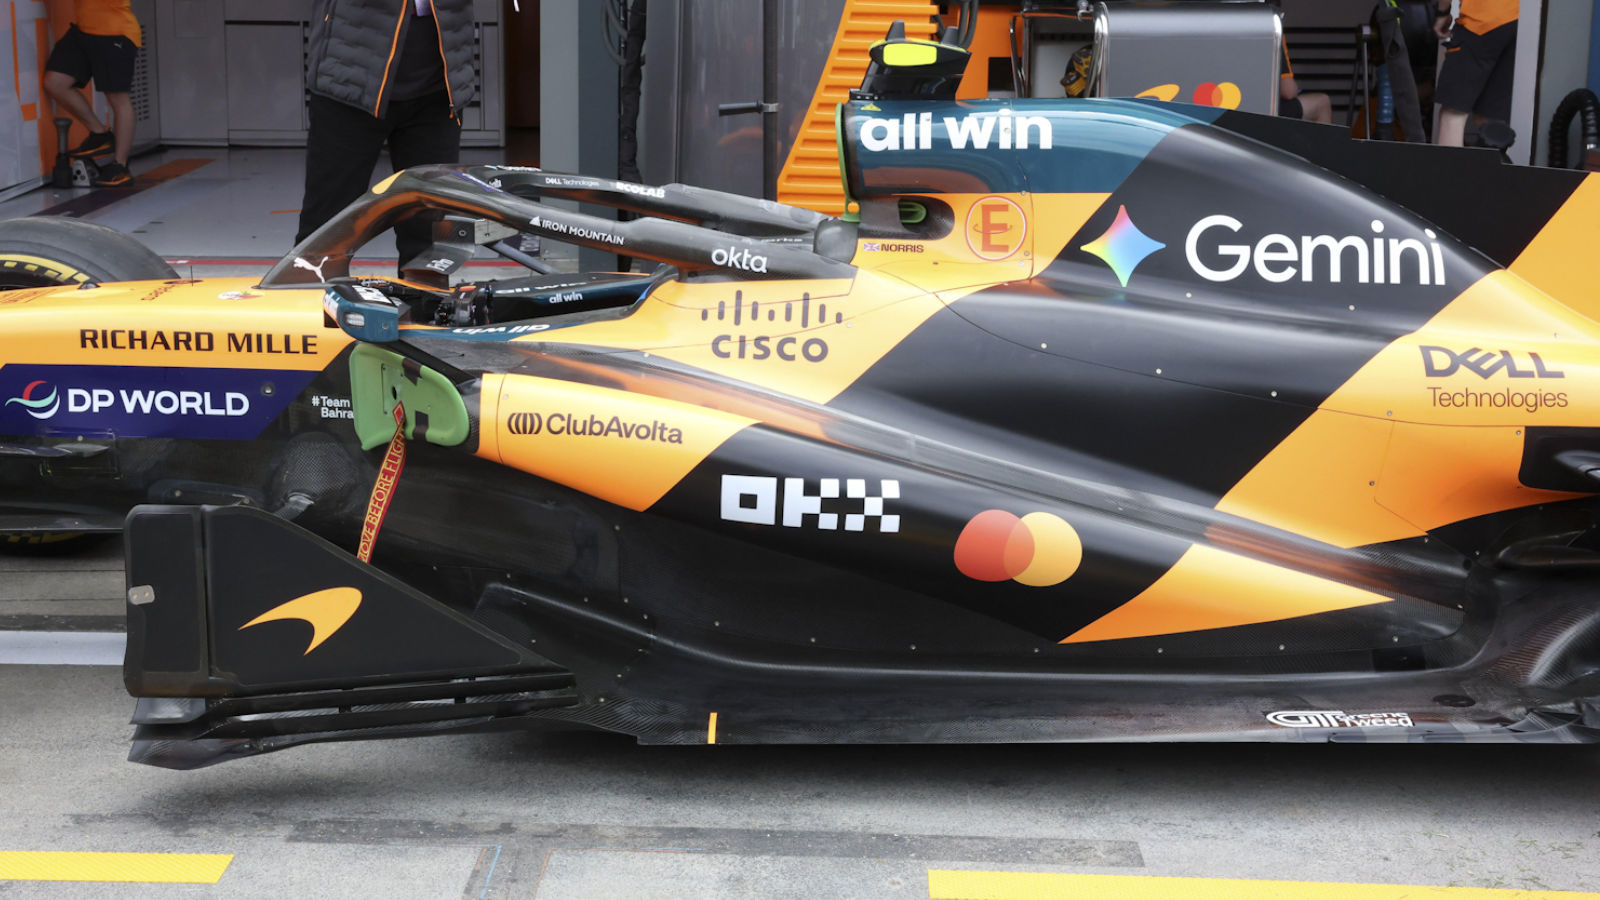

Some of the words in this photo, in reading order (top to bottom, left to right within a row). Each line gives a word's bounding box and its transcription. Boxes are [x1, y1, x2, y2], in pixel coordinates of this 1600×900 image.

[860, 112, 932, 151] all
[943, 108, 1052, 150] win
[615, 181, 665, 198] ECOLAB
[542, 219, 566, 234] IRON
[568, 222, 625, 245] MOUNTAIN
[711, 246, 768, 274] okta
[881, 243, 924, 253] NORRIS
[1185, 214, 1446, 286] Gemini
[549, 292, 562, 304] all
[563, 292, 583, 302] win
[80, 329, 214, 352] RICHARD
[228, 332, 318, 355] MILLE
[711, 335, 829, 363] CISCO
[1419, 345, 1566, 380] DELL
[68, 389, 114, 413] DP
[119, 390, 250, 416] WORLD
[312, 395, 350, 407] #Team
[1427, 386, 1569, 412] Technologies
[546, 412, 683, 444] ClubAvolta
[367, 471, 394, 523] BEFORE
[720, 474, 900, 533] OKX
